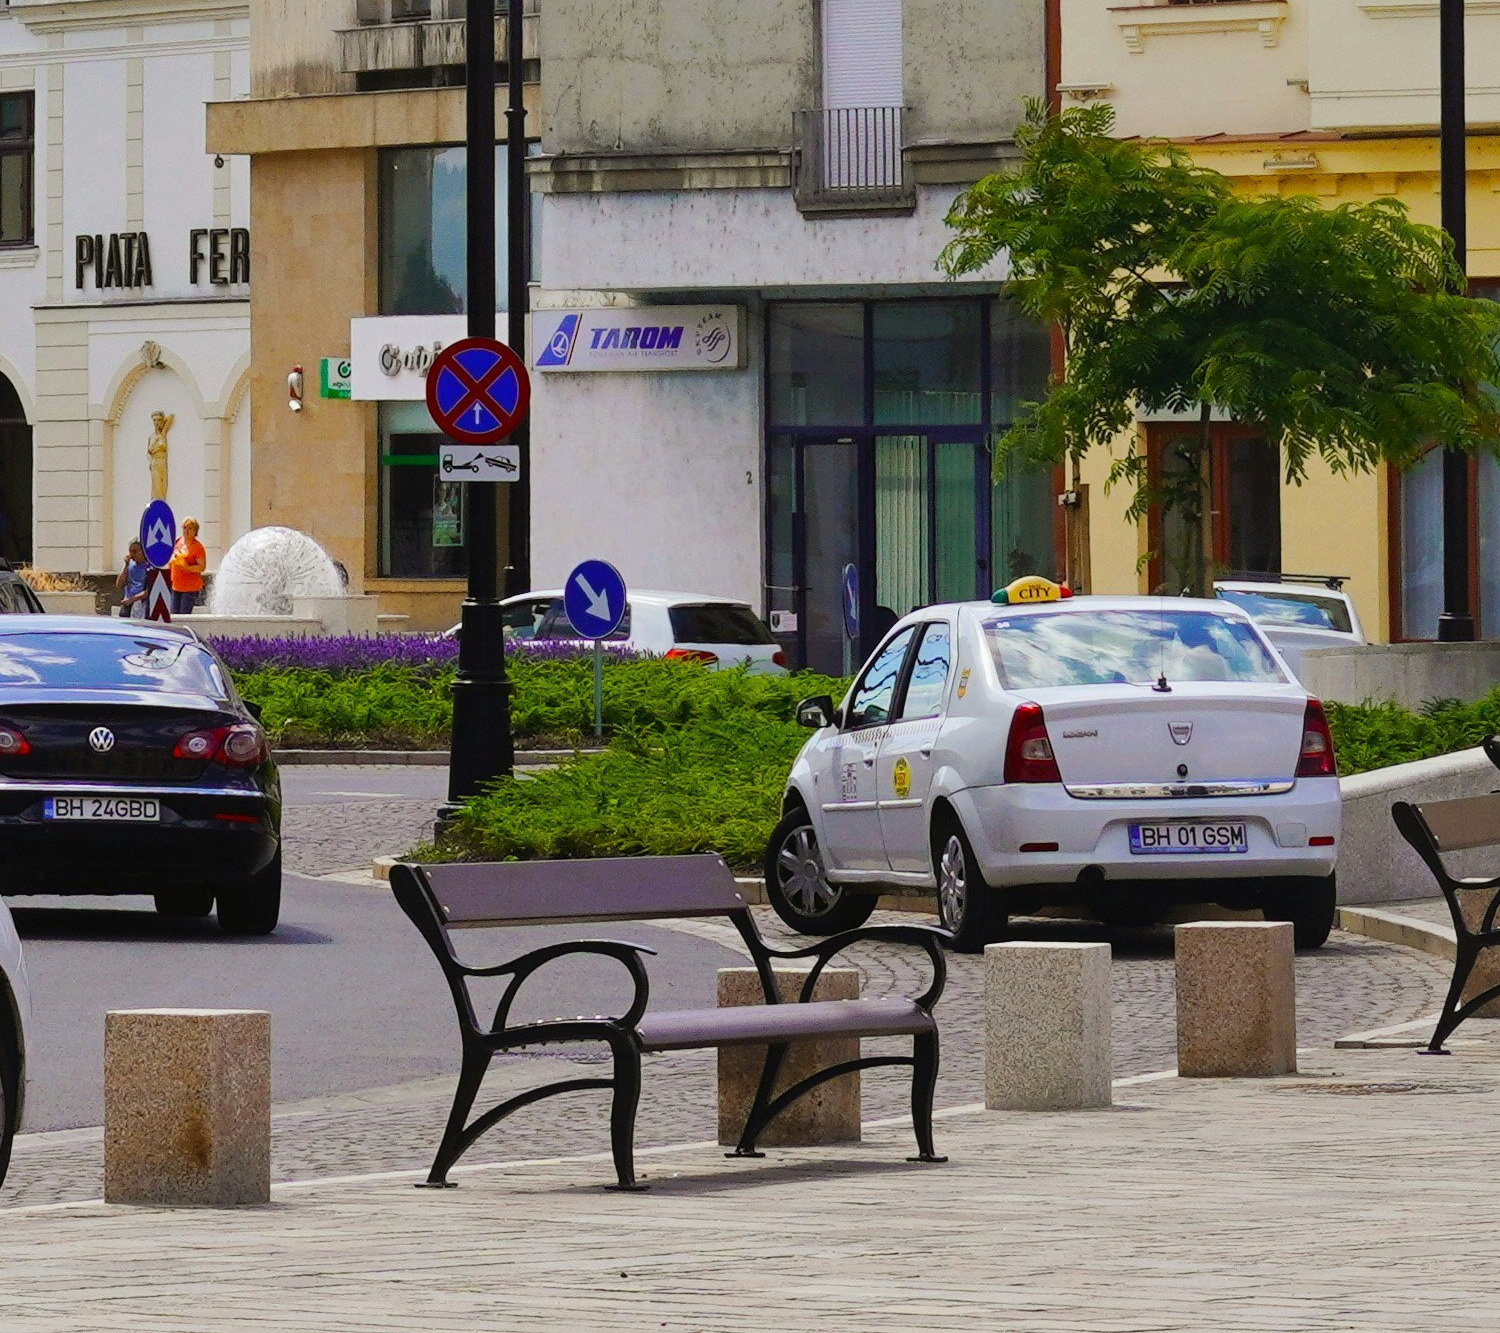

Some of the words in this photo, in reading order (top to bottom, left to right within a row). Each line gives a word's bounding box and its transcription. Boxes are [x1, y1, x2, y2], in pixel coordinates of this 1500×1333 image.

[75, 232, 153, 289] PIATA
[590, 326, 684, 350] TAROM
[745, 471, 753, 485] 2
[1019, 587, 1052, 600] CITY
[55, 798, 84, 817] BH
[1142, 827, 1171, 847] BH
[1177, 826, 1197, 846] 01
[1202, 825, 1244, 846] GSM
